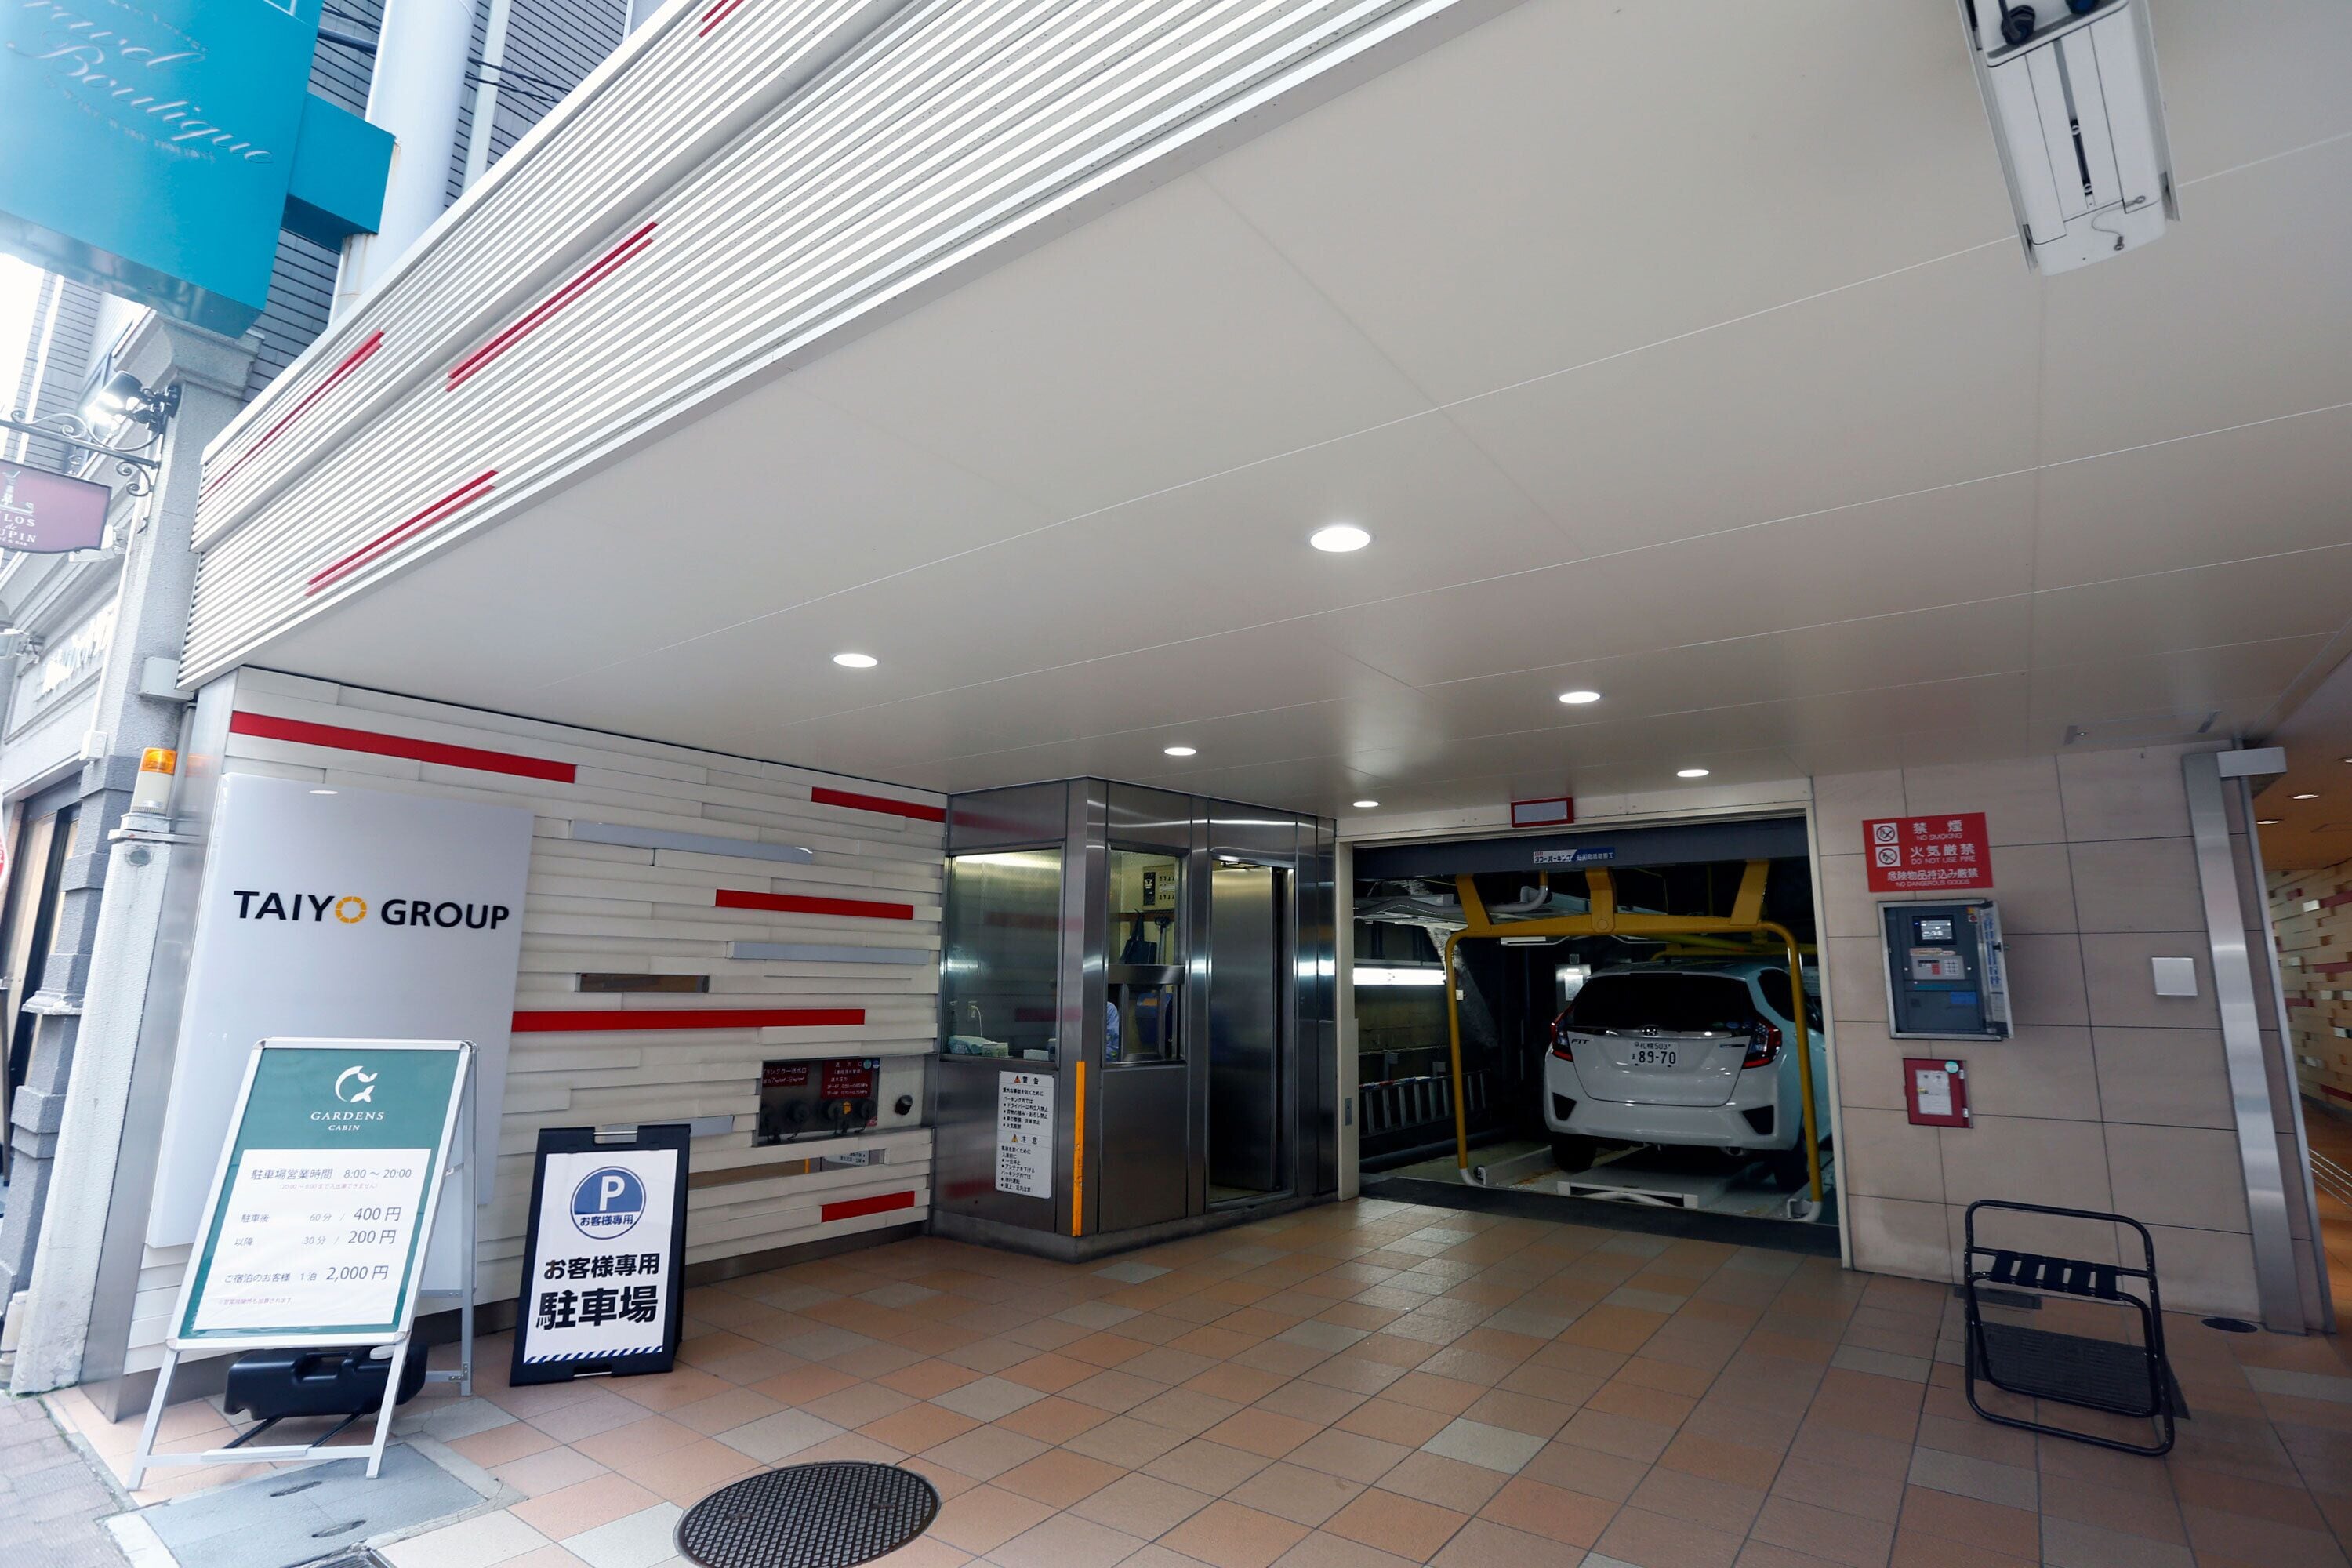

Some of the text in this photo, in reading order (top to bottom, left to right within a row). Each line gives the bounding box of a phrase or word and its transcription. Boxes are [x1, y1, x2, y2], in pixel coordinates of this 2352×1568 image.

[8, 30, 274, 164] Boutique
[4, 513, 36, 528] LOS
[1910, 843, 1975, 858] 火気厳禁
[234, 890, 510, 930] TAIYO GROUP
[1639, 1051, 1676, 1064] 89-70
[310, 1112, 385, 1120] GARDENS
[1021, 1135, 1037, 1145] 注意
[251, 1168, 333, 1180] 駐車場営業時間
[343, 1169, 366, 1178] 8:00
[383, 1168, 412, 1178] 20:00
[599, 1175, 625, 1211] P
[241, 1214, 270, 1223] 駐車後
[234, 1236, 253, 1247] 以降
[224, 1272, 291, 1283] ご宿泊のお客様
[535, 1285, 659, 1331] 駐車場
